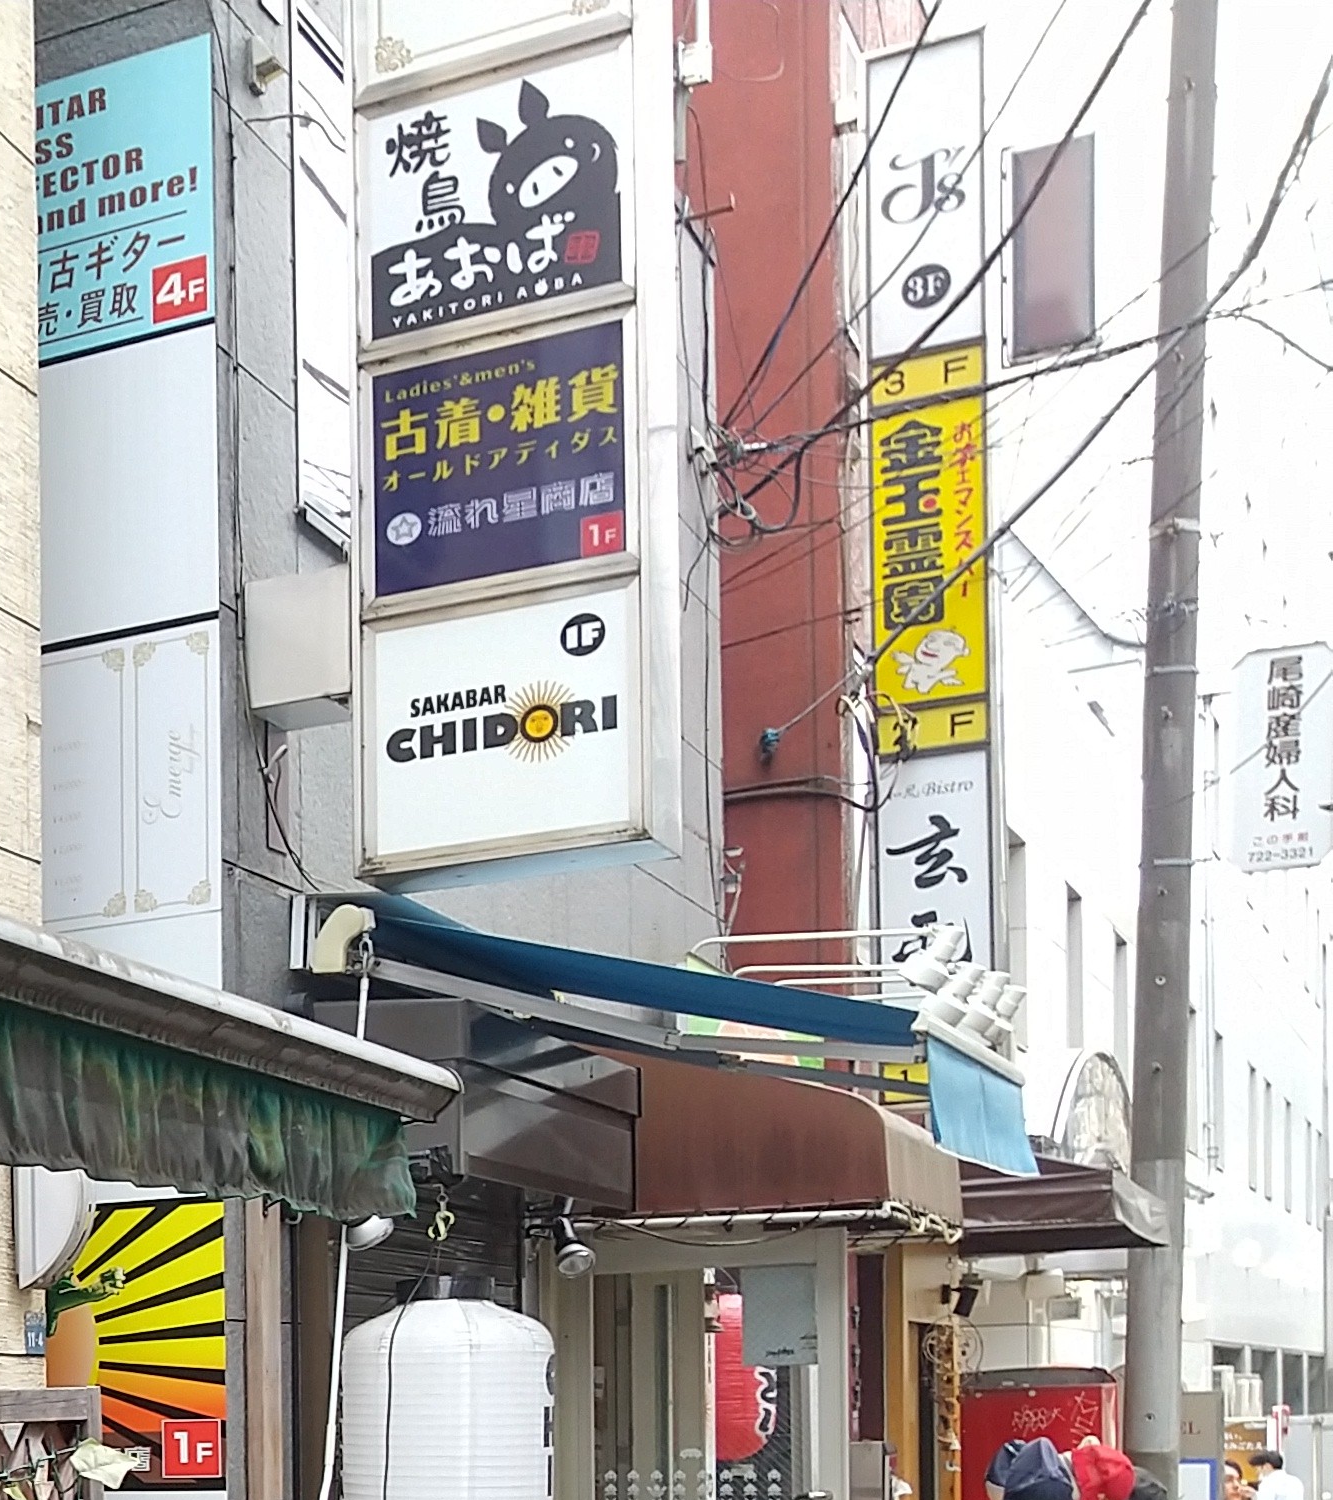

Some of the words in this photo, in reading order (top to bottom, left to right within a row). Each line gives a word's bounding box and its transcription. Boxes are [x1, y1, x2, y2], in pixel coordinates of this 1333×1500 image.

[35, 87, 106, 130] ITAR
[35, 132, 73, 164] SS
[35, 147, 143, 198] ECTOR
[37, 198, 85, 235] nd
[98, 166, 197, 218] more!
[388, 211, 575, 307] あおば
[156, 272, 205, 307] 4F
[906, 273, 945, 303] 3F
[37, 283, 137, 336] 売・買取
[392, 291, 503, 329] YAKITORI
[588, 523, 617, 547] 1F
[565, 620, 601, 650] 1F
[410, 684, 506, 718] SAKABAR
[386, 694, 618, 763] CHIDORI
[173, 1431, 214, 1464] 1F
